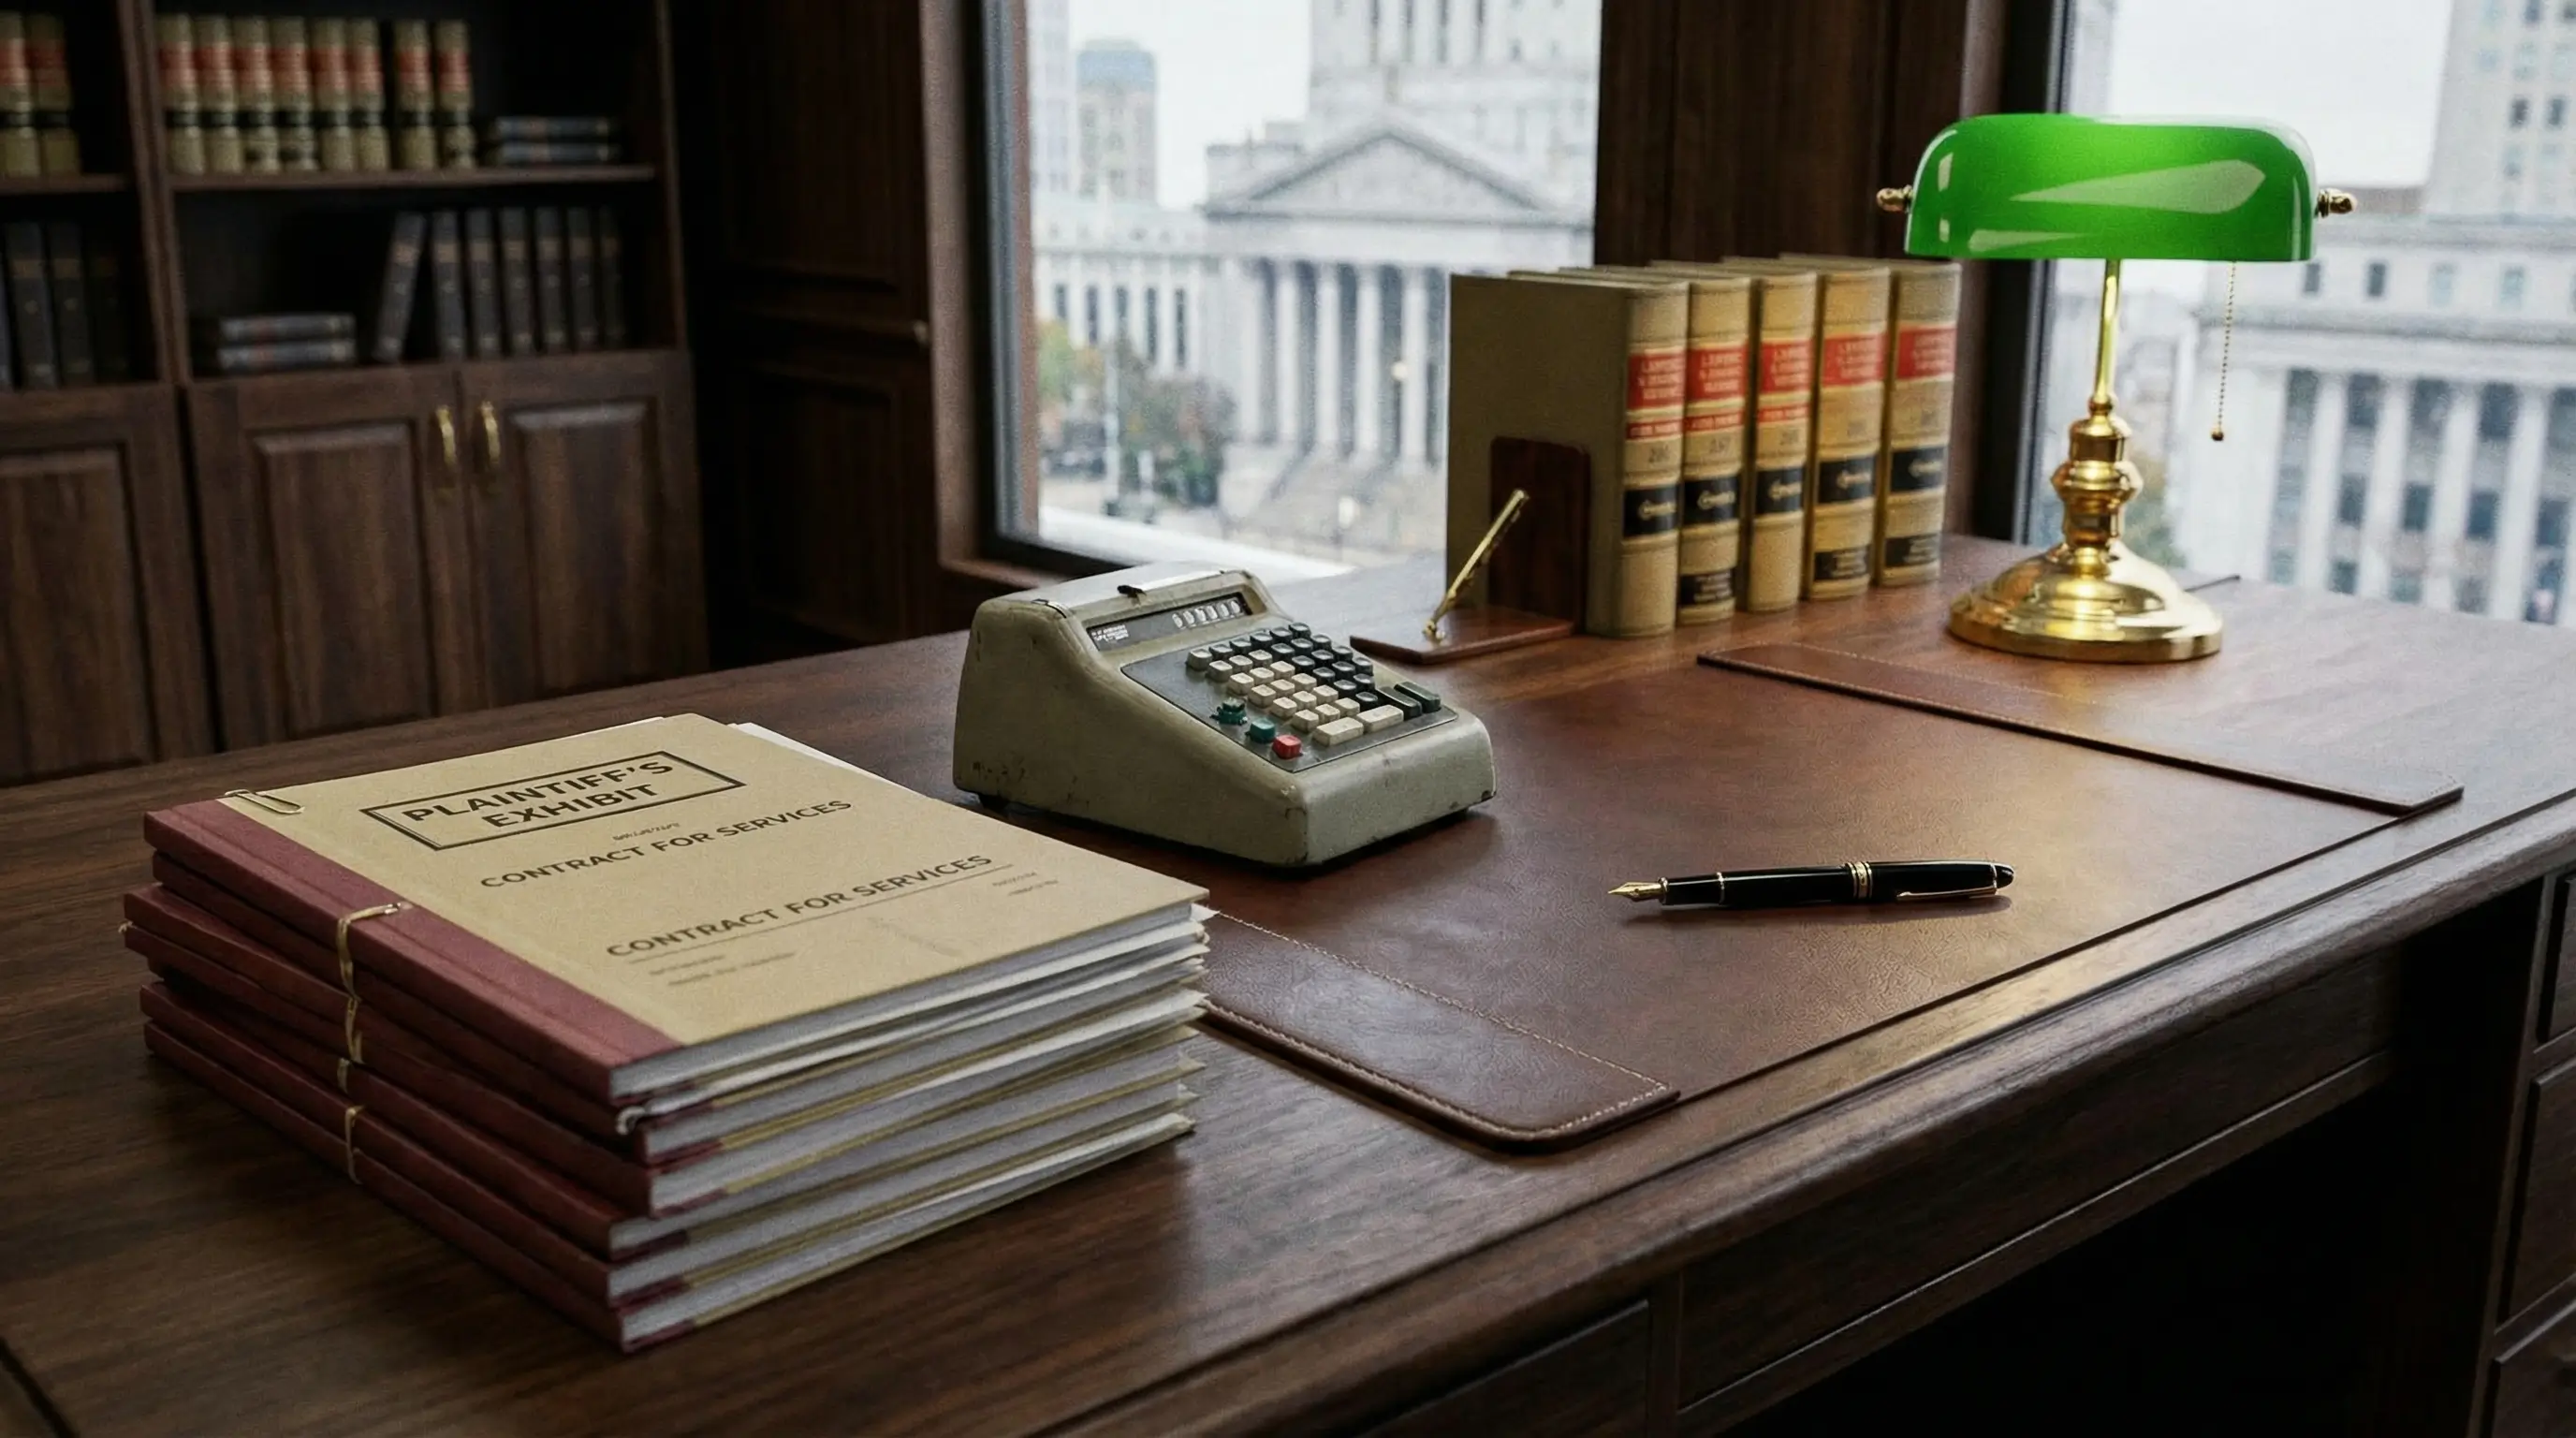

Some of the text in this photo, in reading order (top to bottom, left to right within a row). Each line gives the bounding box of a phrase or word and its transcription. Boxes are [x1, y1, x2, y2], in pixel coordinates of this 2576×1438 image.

[402, 761, 674, 822] PLAINTIFF'S
[481, 784, 658, 829] EXHIBIT
[480, 845, 646, 888] CONTRACT
[651, 832, 716, 853] FOR
[716, 800, 853, 837] SERVICES
[606, 855, 993, 958] CONTRACT FOR SERVICES
